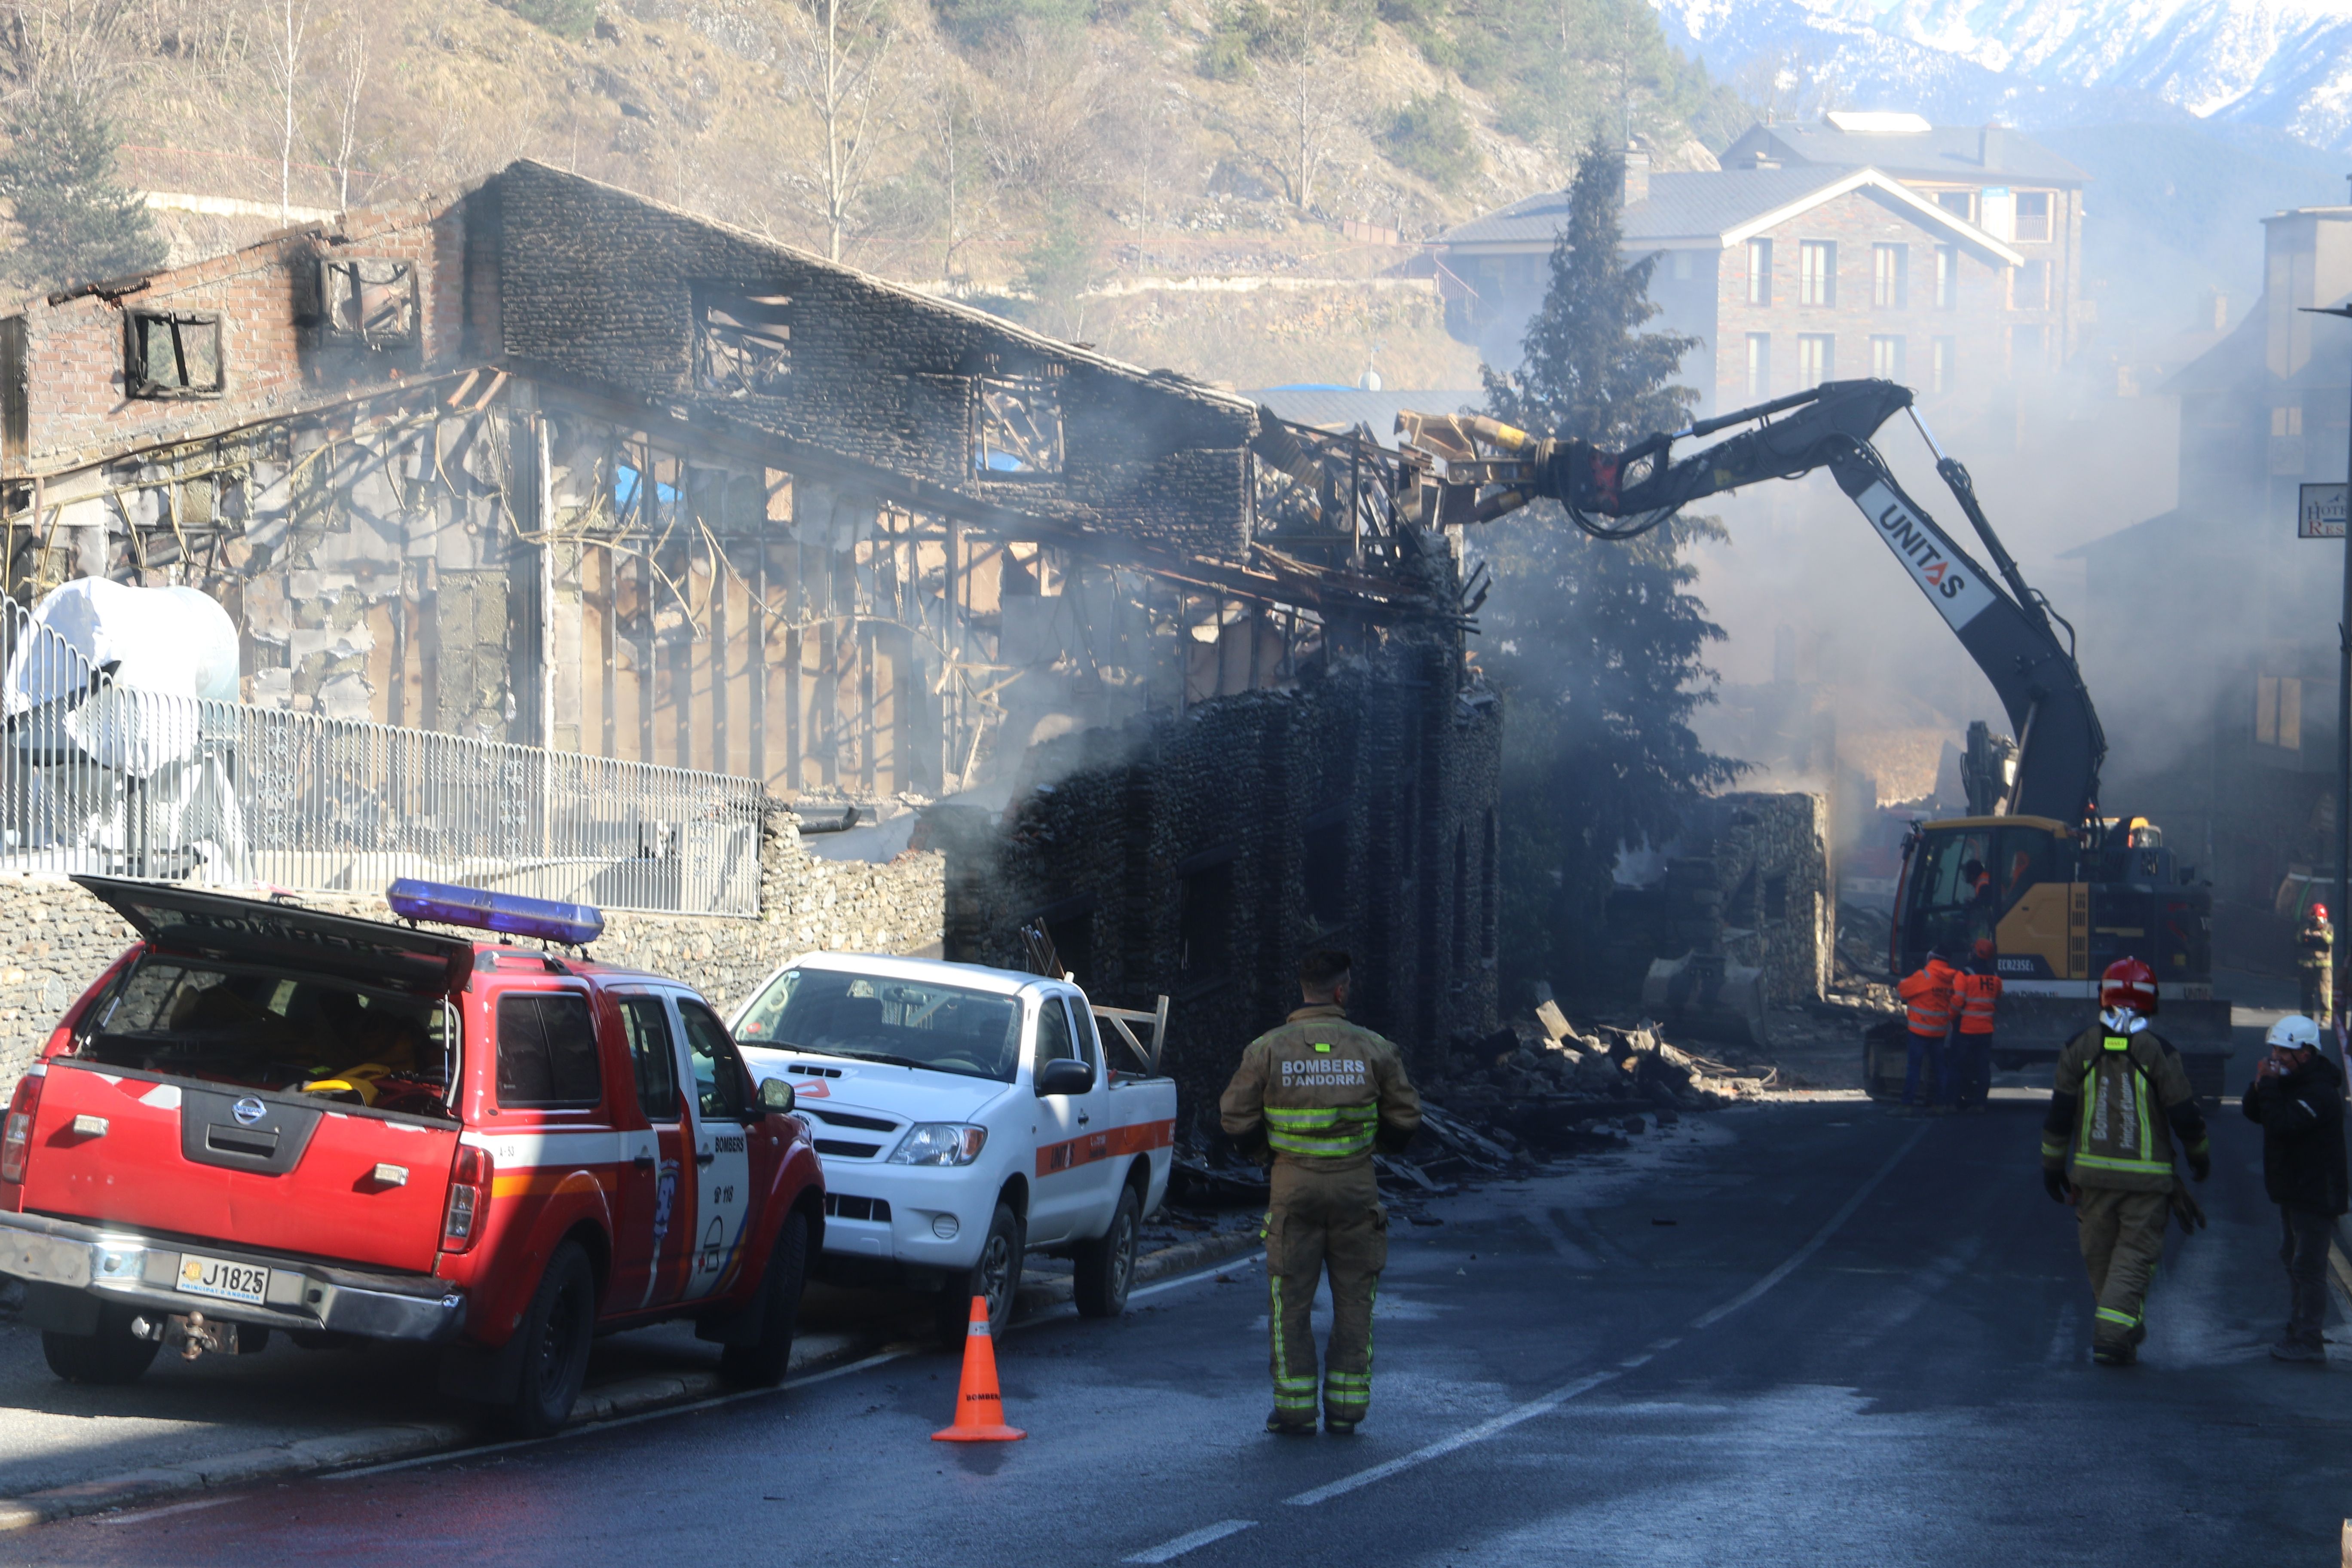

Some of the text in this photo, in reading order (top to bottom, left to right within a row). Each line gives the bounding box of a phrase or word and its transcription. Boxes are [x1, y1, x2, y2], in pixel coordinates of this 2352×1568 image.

[1880, 503, 1964, 599] UNITAS
[1282, 1059, 1365, 1075] BOMBERS
[1282, 1074, 1366, 1087] D'ANDORRA
[235, 1105, 262, 1115] NISSAN
[715, 1136, 744, 1153] BOMBERS
[723, 1185, 734, 1203] 118
[202, 1263, 265, 1293] J1825
[181, 1283, 218, 1294] PRINCIPAT
[966, 1393, 1001, 1401] BOMBER
